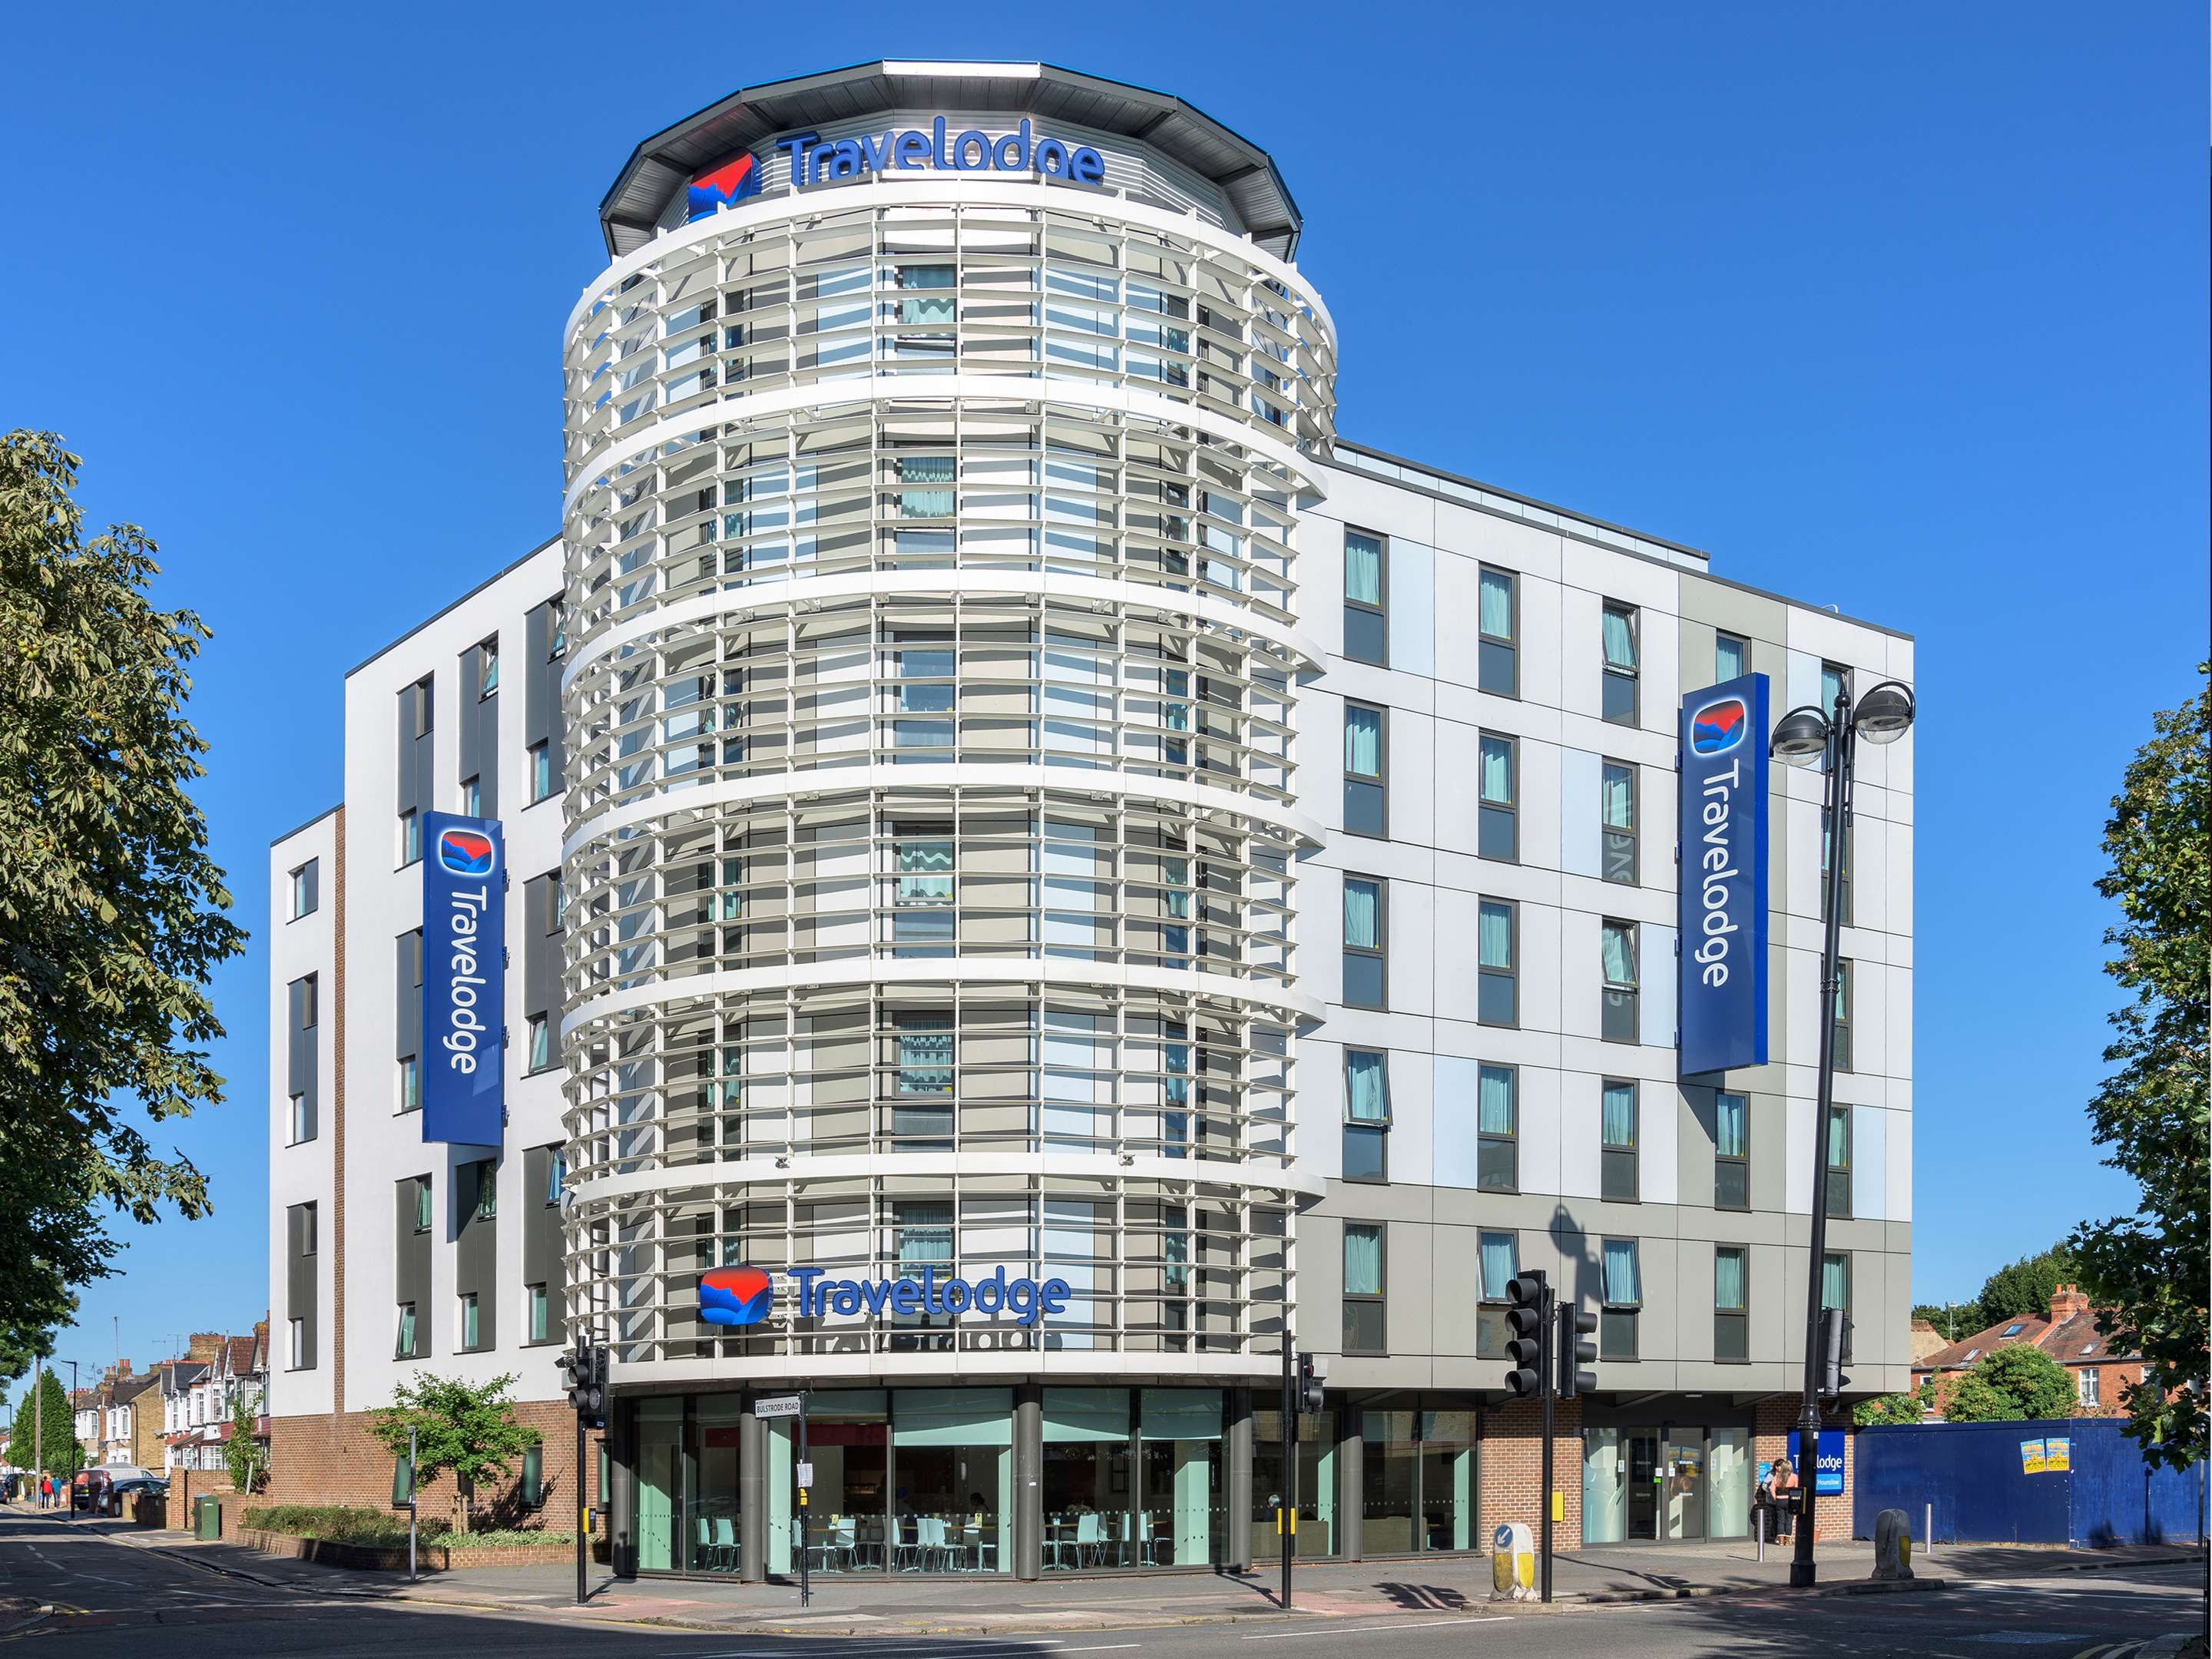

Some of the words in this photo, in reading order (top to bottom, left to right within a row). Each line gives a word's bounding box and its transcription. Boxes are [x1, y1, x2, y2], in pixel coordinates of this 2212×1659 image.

[1694, 758, 1739, 988] Travelodge
[442, 885, 487, 1075] Travelodge
[786, 1264, 1071, 1326] Travelodge
[757, 1403, 783, 1413] BULSTRODE
[1793, 1454, 1843, 1471] Tlodge
